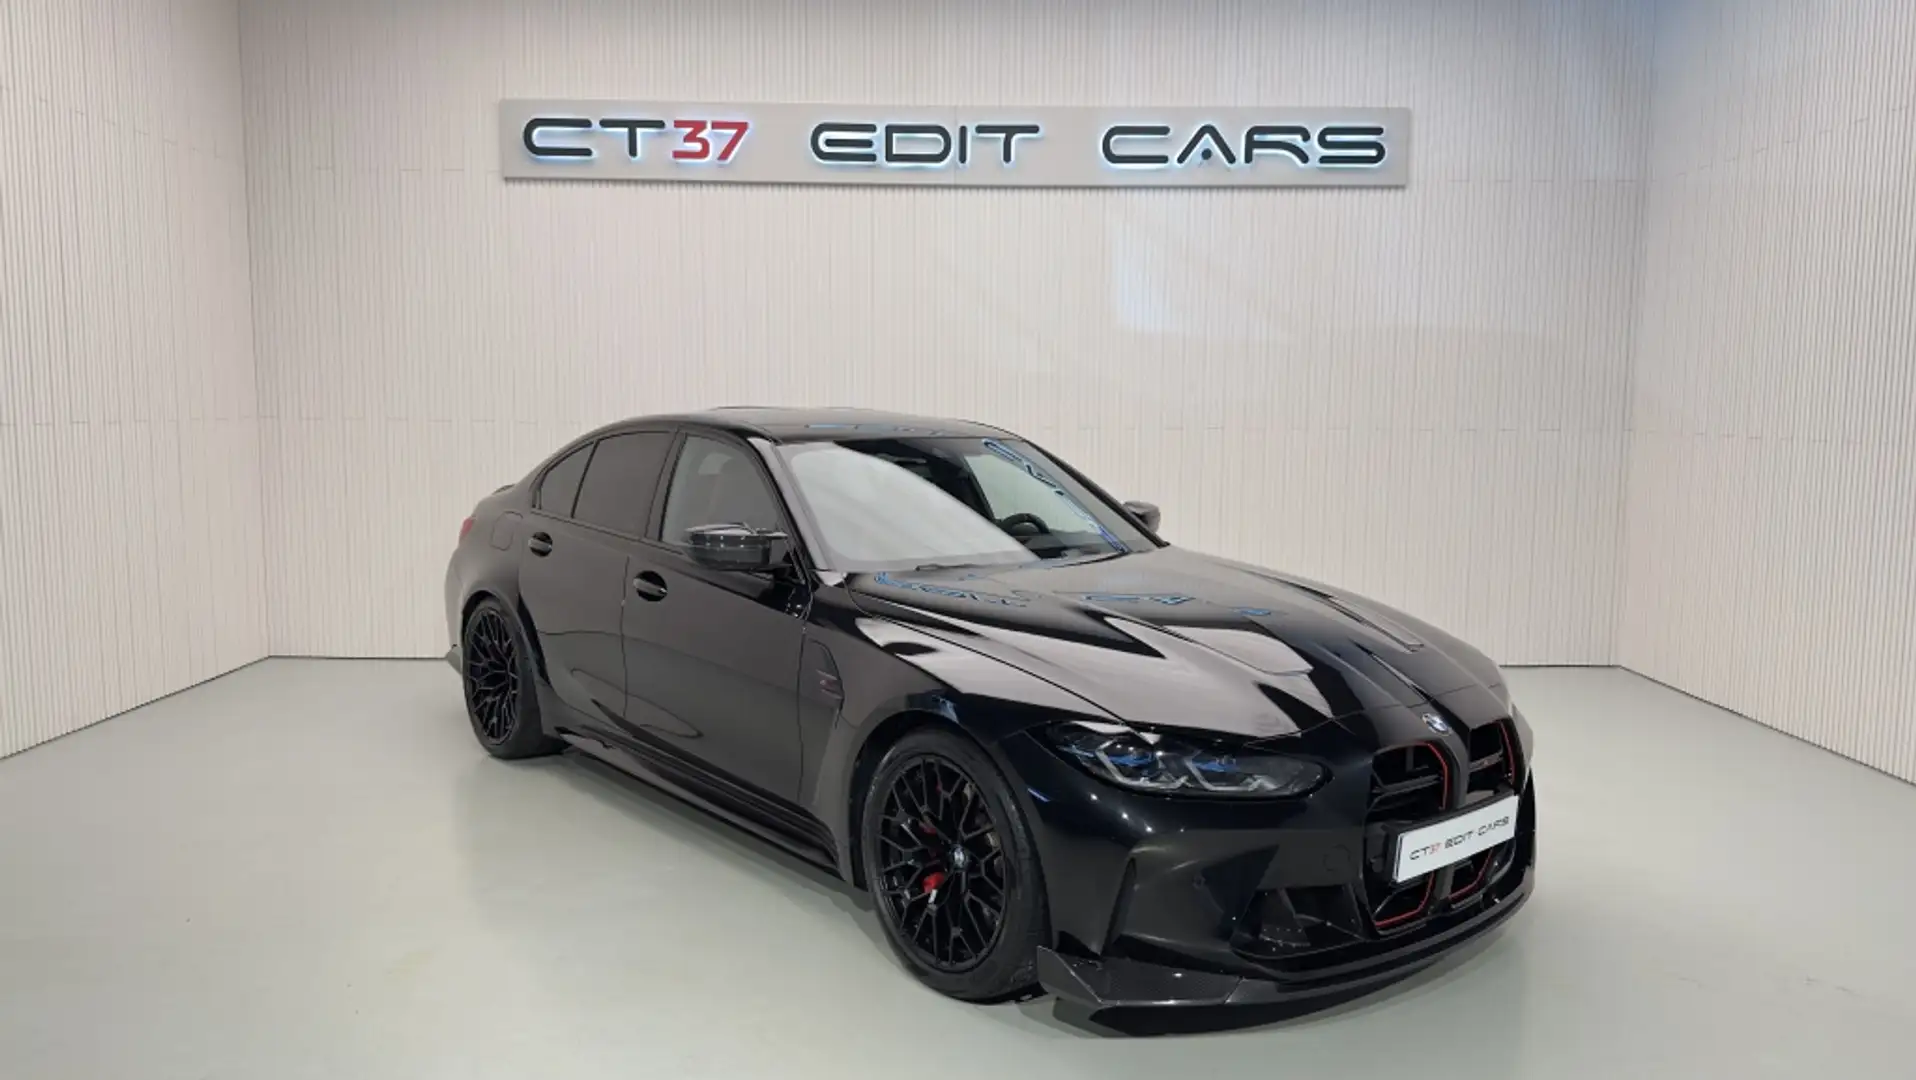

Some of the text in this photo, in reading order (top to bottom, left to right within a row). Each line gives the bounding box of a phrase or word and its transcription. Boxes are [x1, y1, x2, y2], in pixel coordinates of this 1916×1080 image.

[522, 117, 1387, 166] CT37 EDIT CARS
